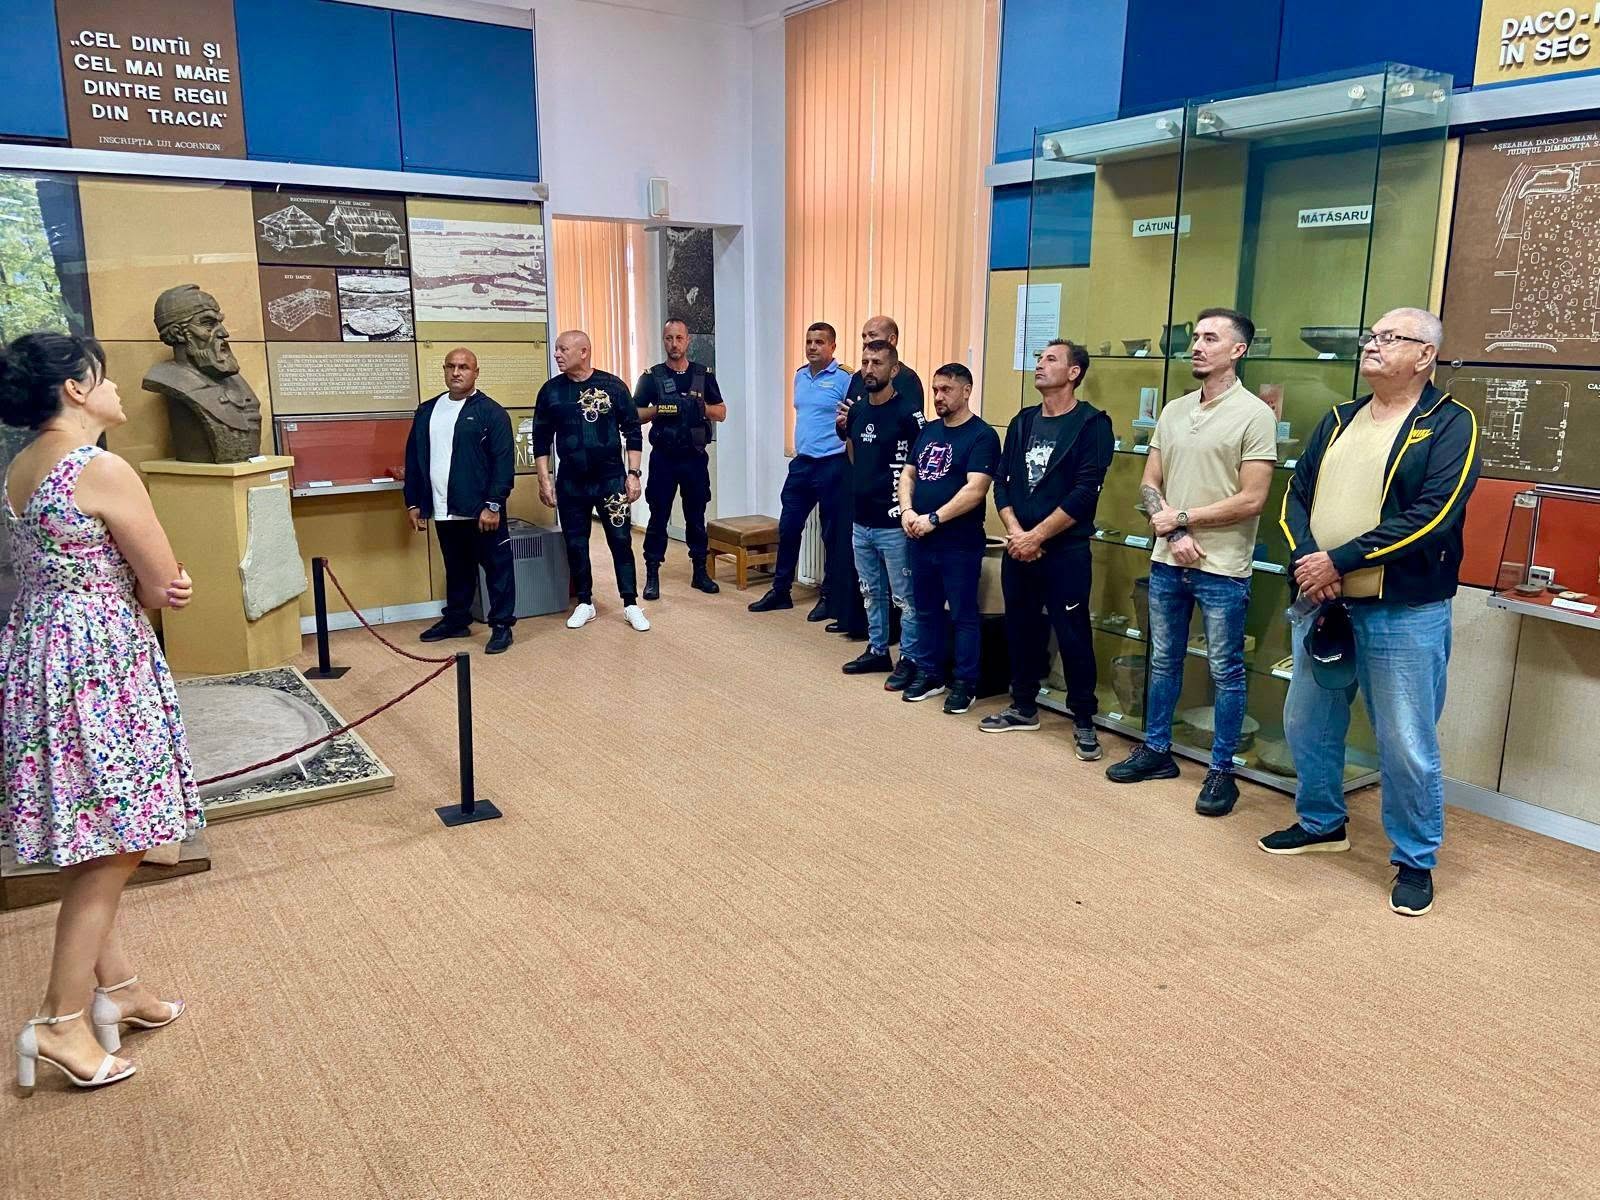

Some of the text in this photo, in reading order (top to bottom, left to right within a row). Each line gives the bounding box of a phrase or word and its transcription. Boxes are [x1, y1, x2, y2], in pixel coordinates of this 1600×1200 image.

[1499, 33, 1590, 67] ÎN SEC
[74, 53, 230, 84] CEL MAI MARE
[84, 79, 228, 105] DINTRE REGII
[92, 104, 129, 122] DIN
[157, 139, 172, 148] LUI
[174, 141, 221, 151] ACORNION
